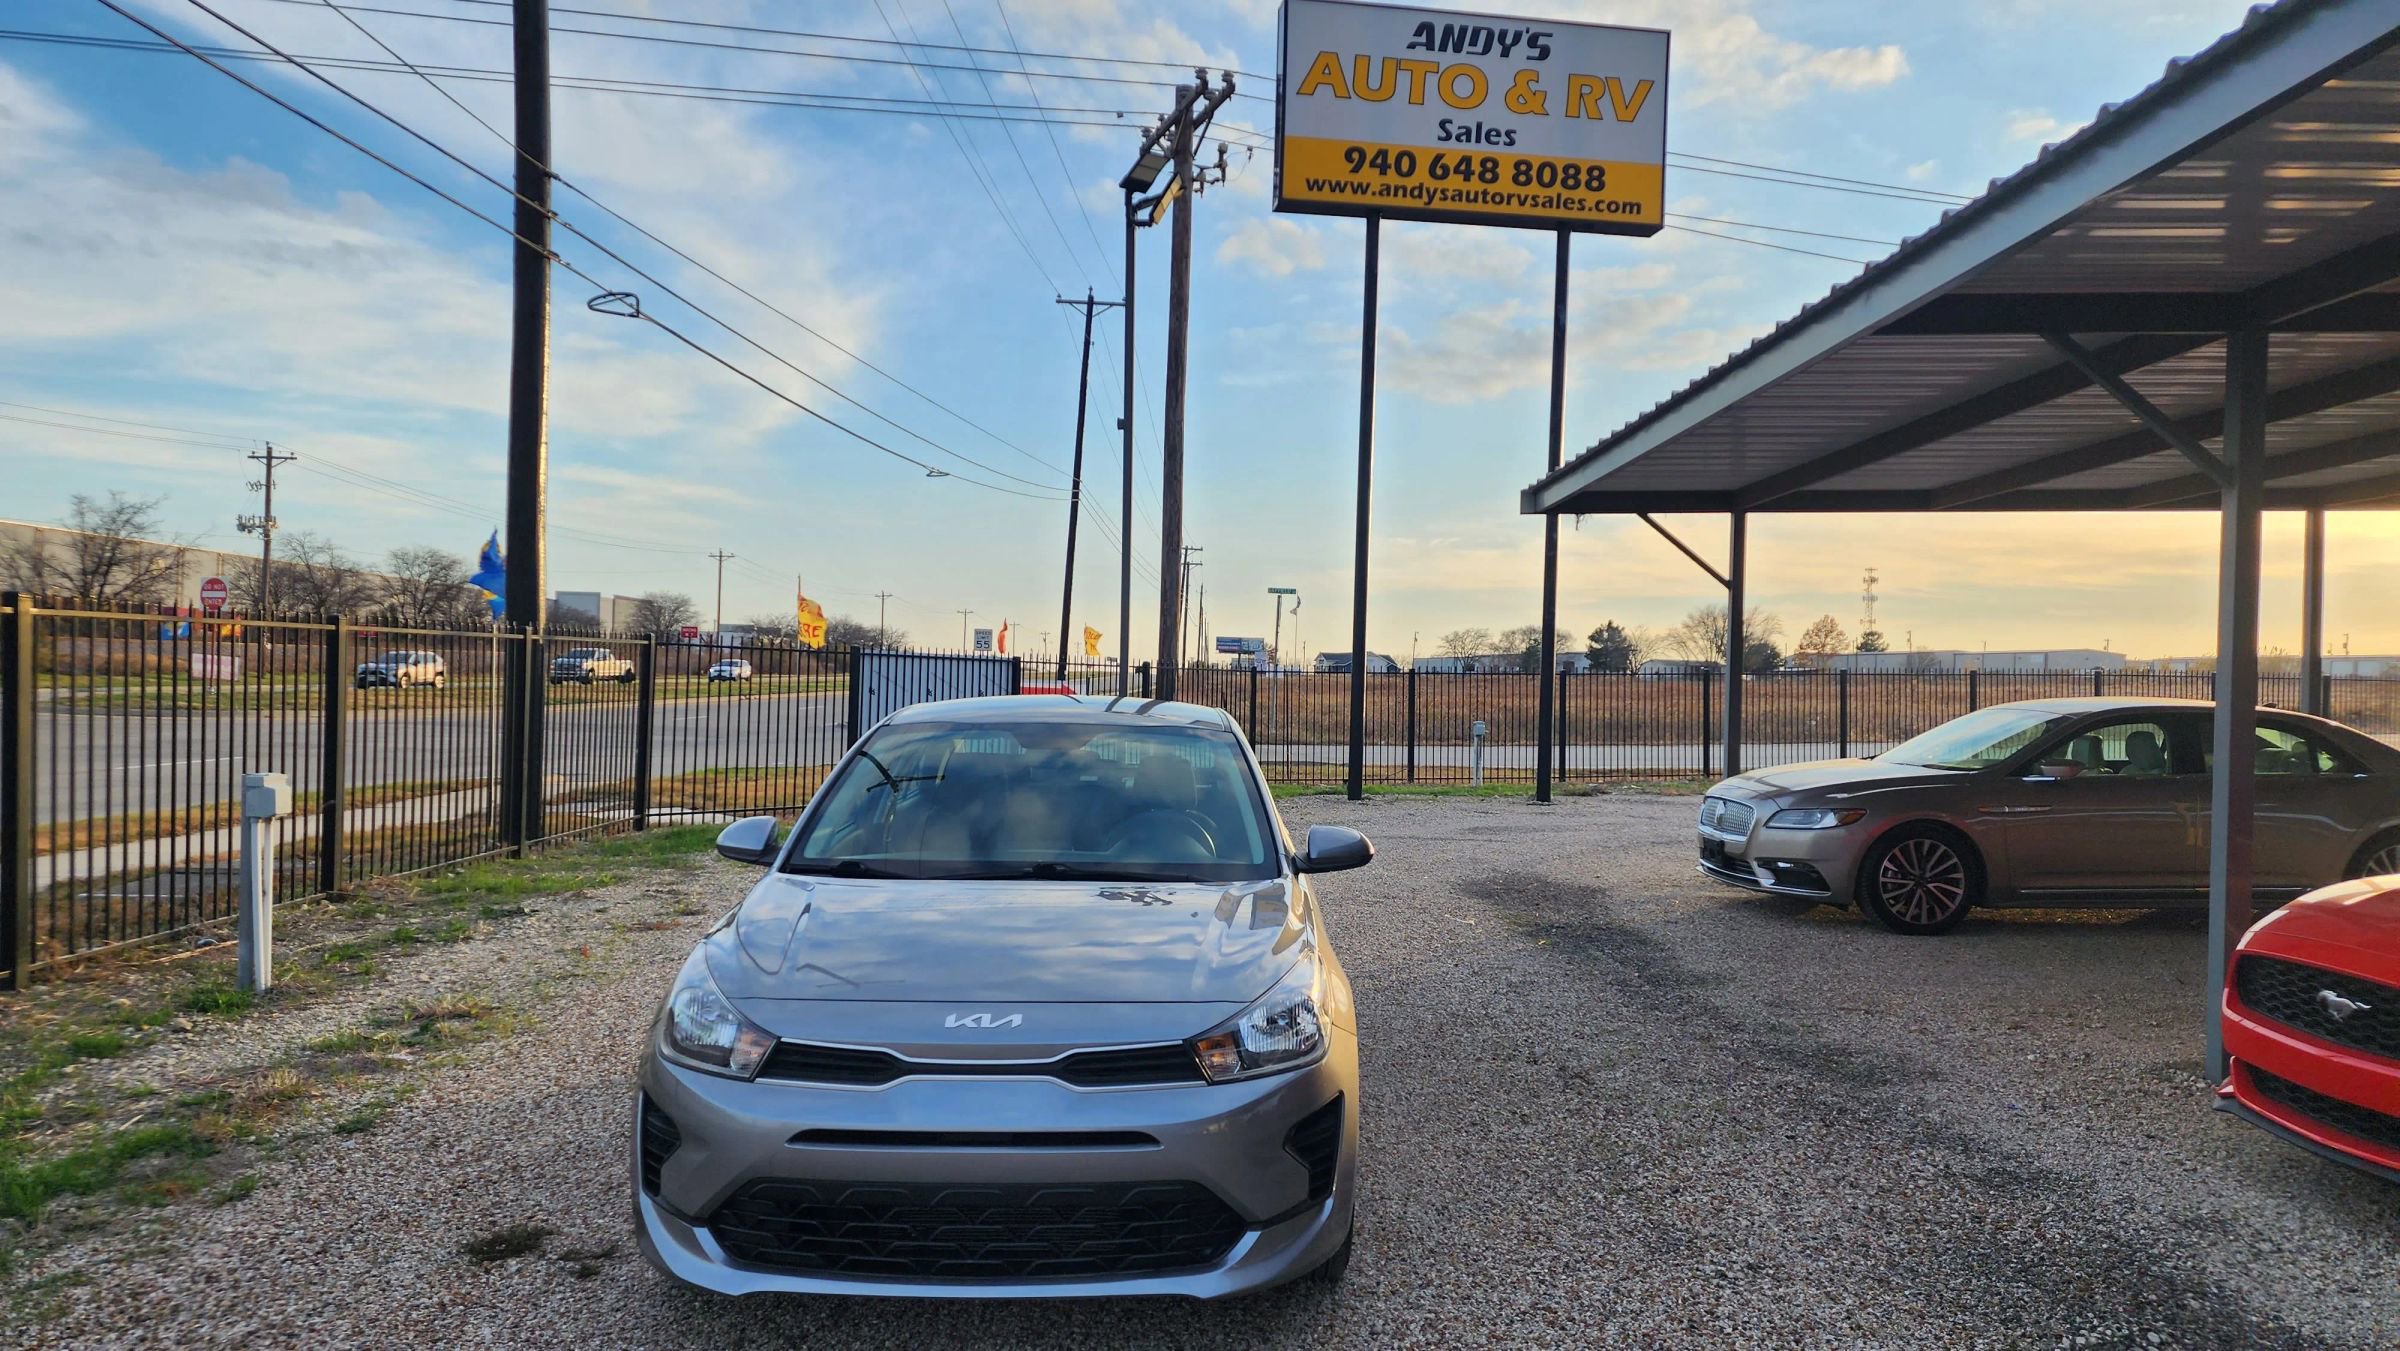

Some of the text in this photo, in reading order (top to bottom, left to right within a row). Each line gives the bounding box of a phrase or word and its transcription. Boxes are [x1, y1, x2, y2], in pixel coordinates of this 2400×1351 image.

[1406, 20, 1554, 62] ANDY'S
[1296, 50, 1655, 122] AUTO & RV
[1437, 117, 1517, 147] Sales
[1343, 145, 1607, 192] 940 648 8088
[1304, 176, 1643, 216] www.andysautorvsales.com
[976, 640, 990, 648] 55
[944, 1013, 1023, 1029] KIA
